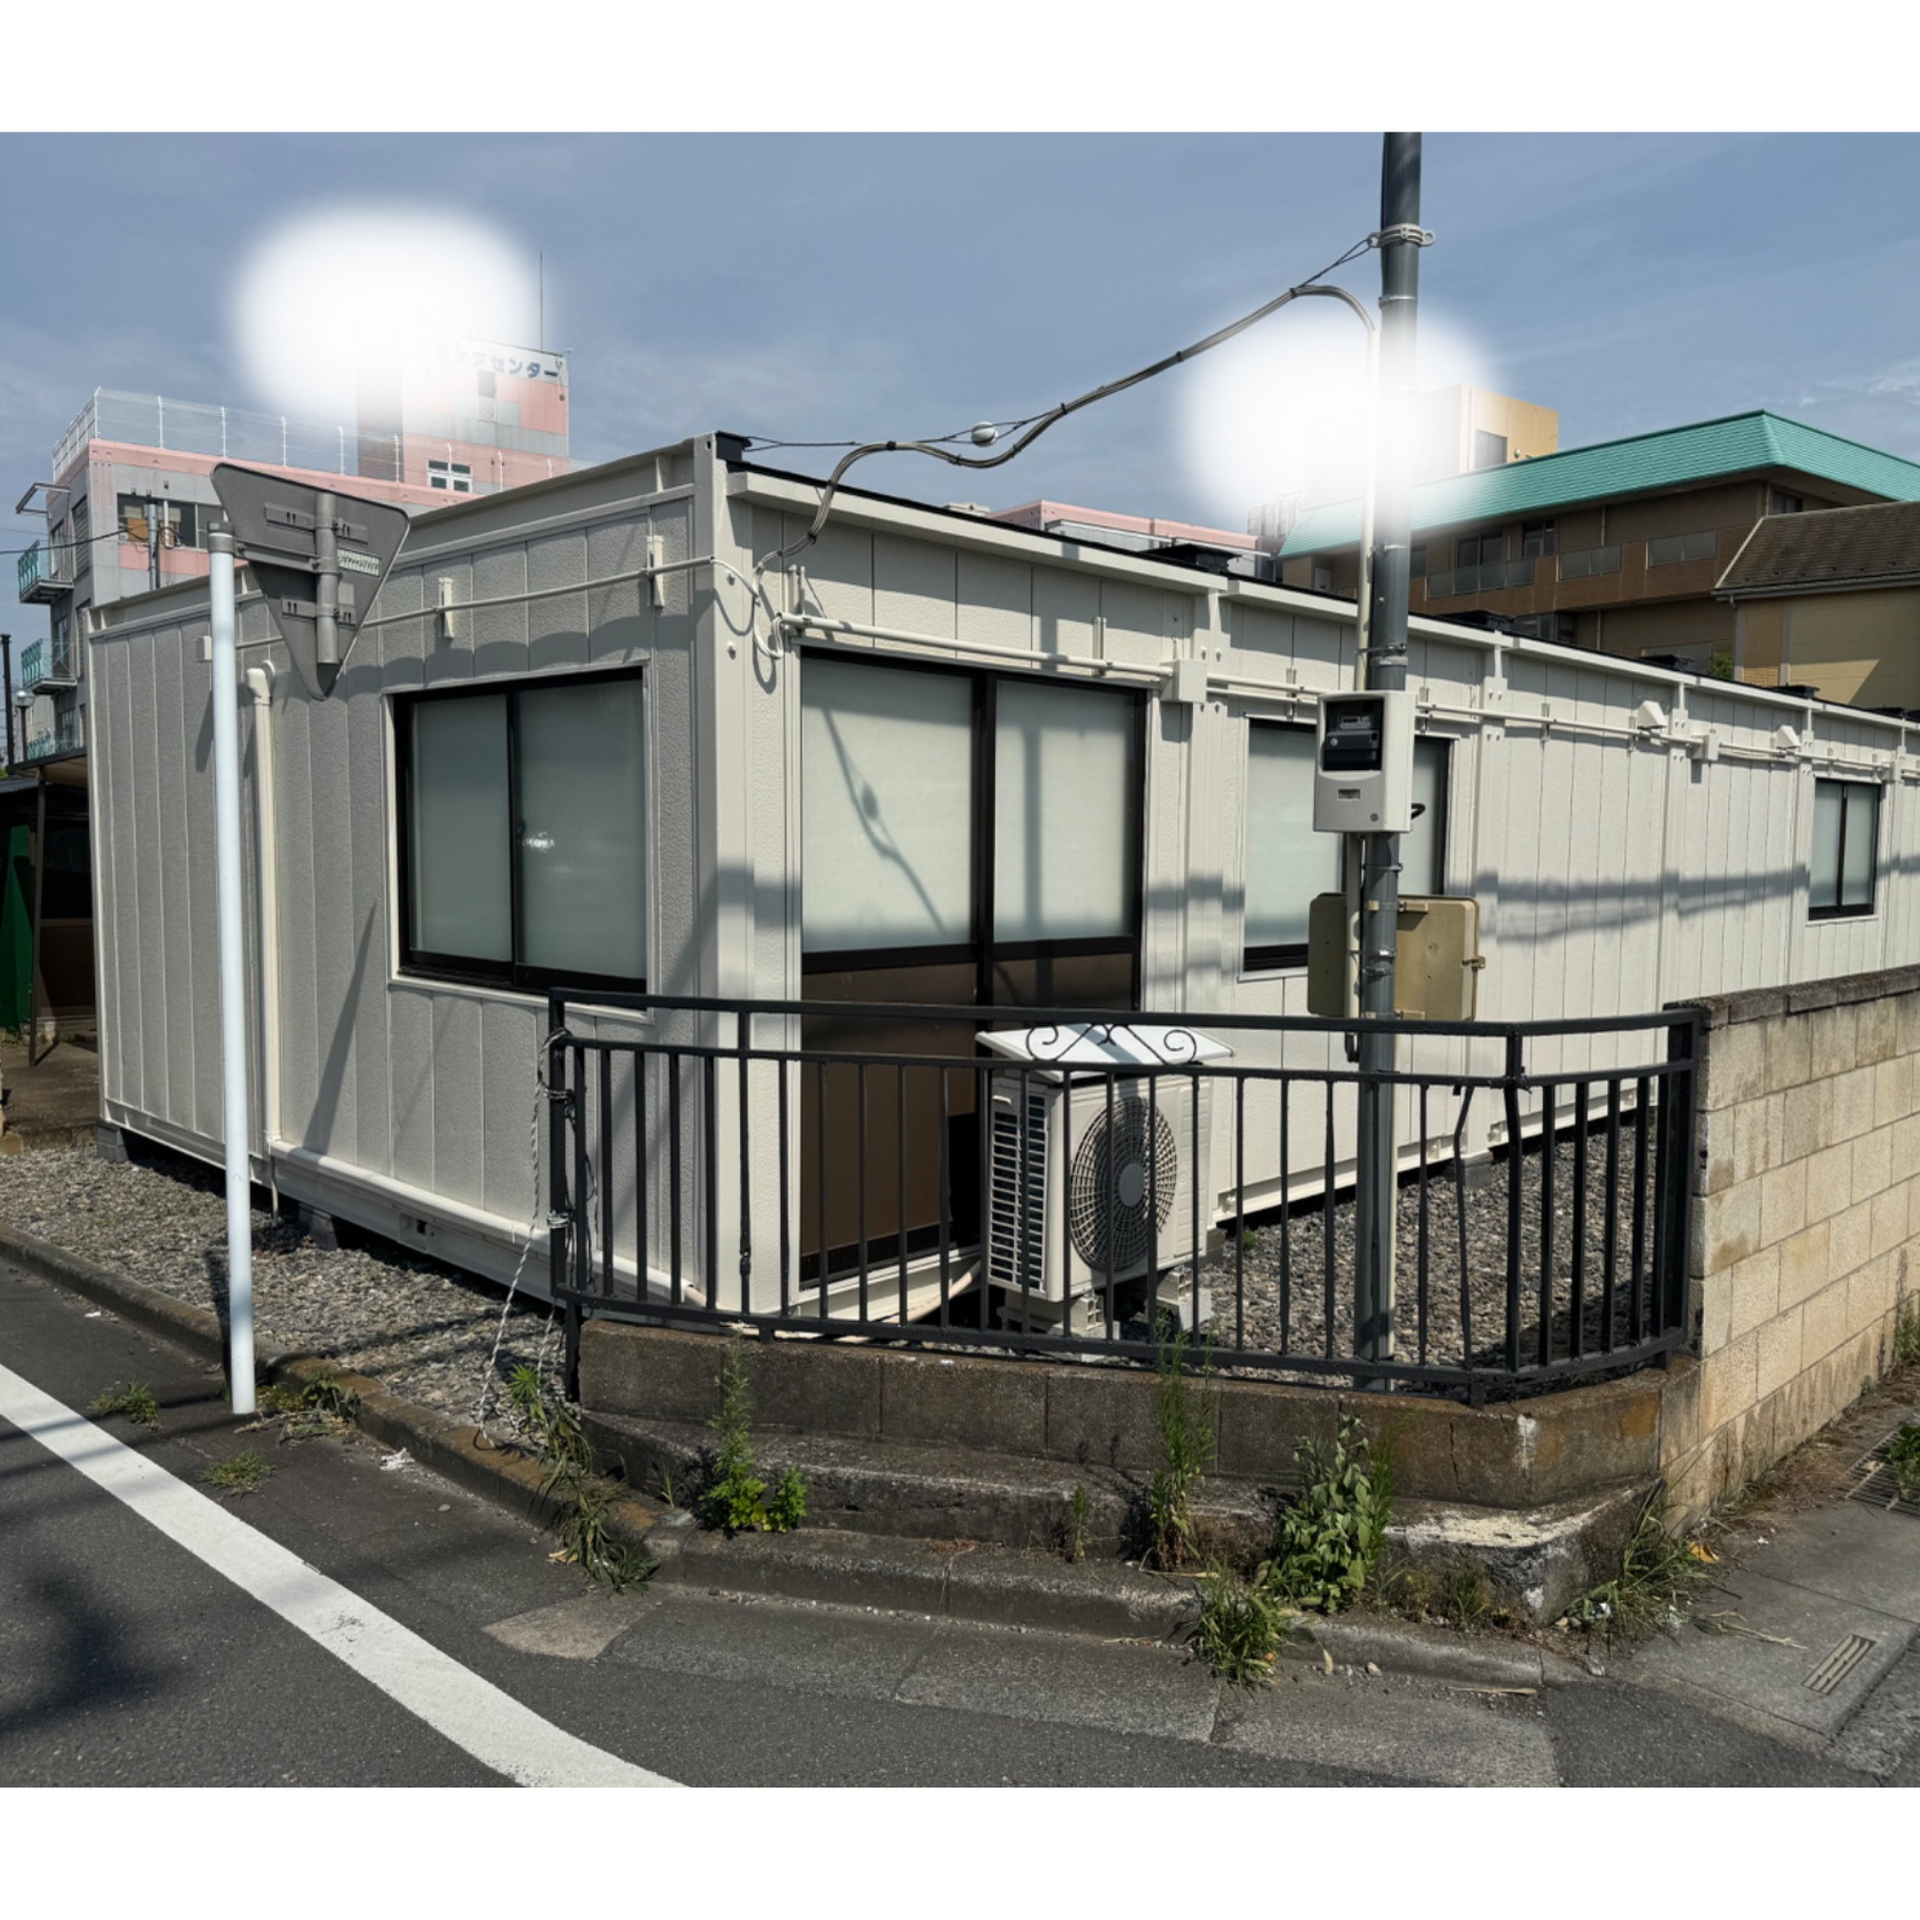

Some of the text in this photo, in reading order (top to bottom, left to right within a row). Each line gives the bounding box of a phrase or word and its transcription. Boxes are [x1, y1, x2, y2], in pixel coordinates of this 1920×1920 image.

[434, 345, 558, 378] ケアセンター
